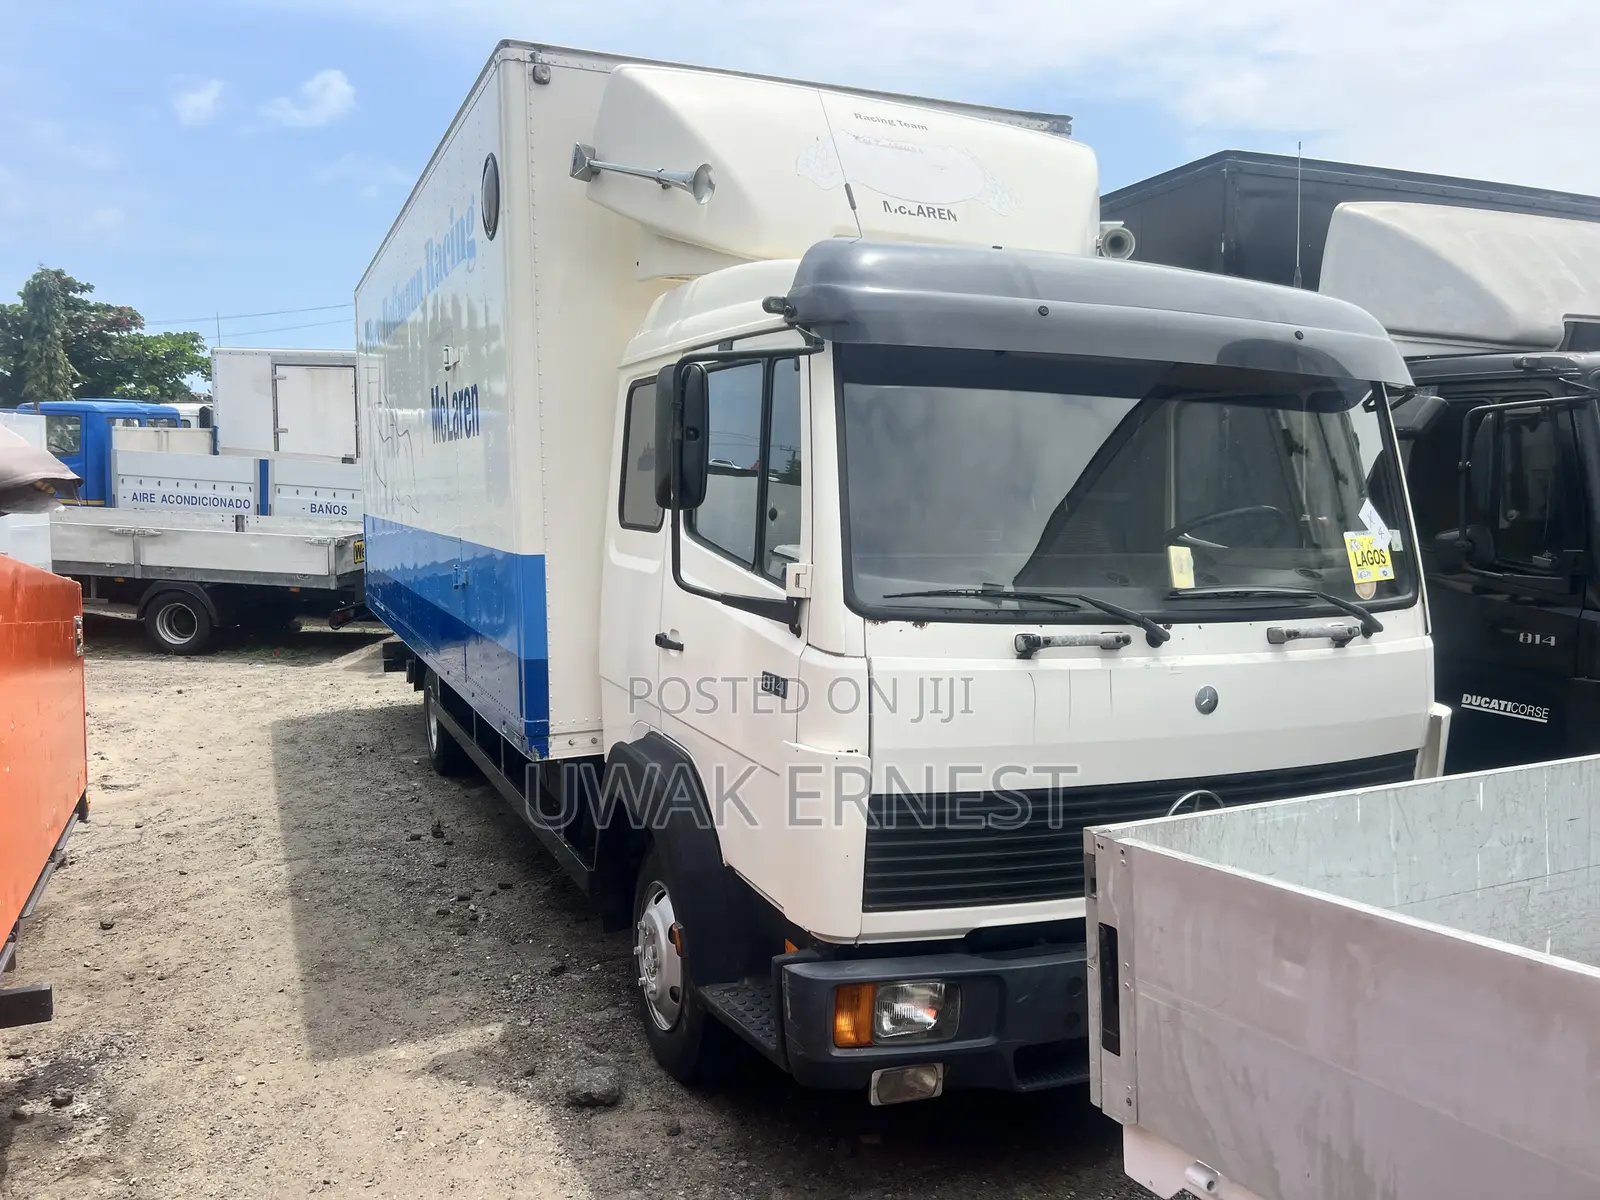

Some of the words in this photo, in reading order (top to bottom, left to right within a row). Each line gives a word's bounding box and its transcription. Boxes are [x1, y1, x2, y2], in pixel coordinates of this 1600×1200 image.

[854, 112, 896, 127] Racing
[898, 119, 929, 131] Team
[424, 194, 477, 294] Racing
[431, 380, 480, 444] McLaren
[131, 491, 156, 503] AIRE
[160, 493, 251, 509] ACONDICIONADO
[310, 500, 348, 516] BAÑOS
[1354, 549, 1386, 567] LAGOS
[1519, 632, 1556, 647] 814
[762, 674, 785, 696] 814
